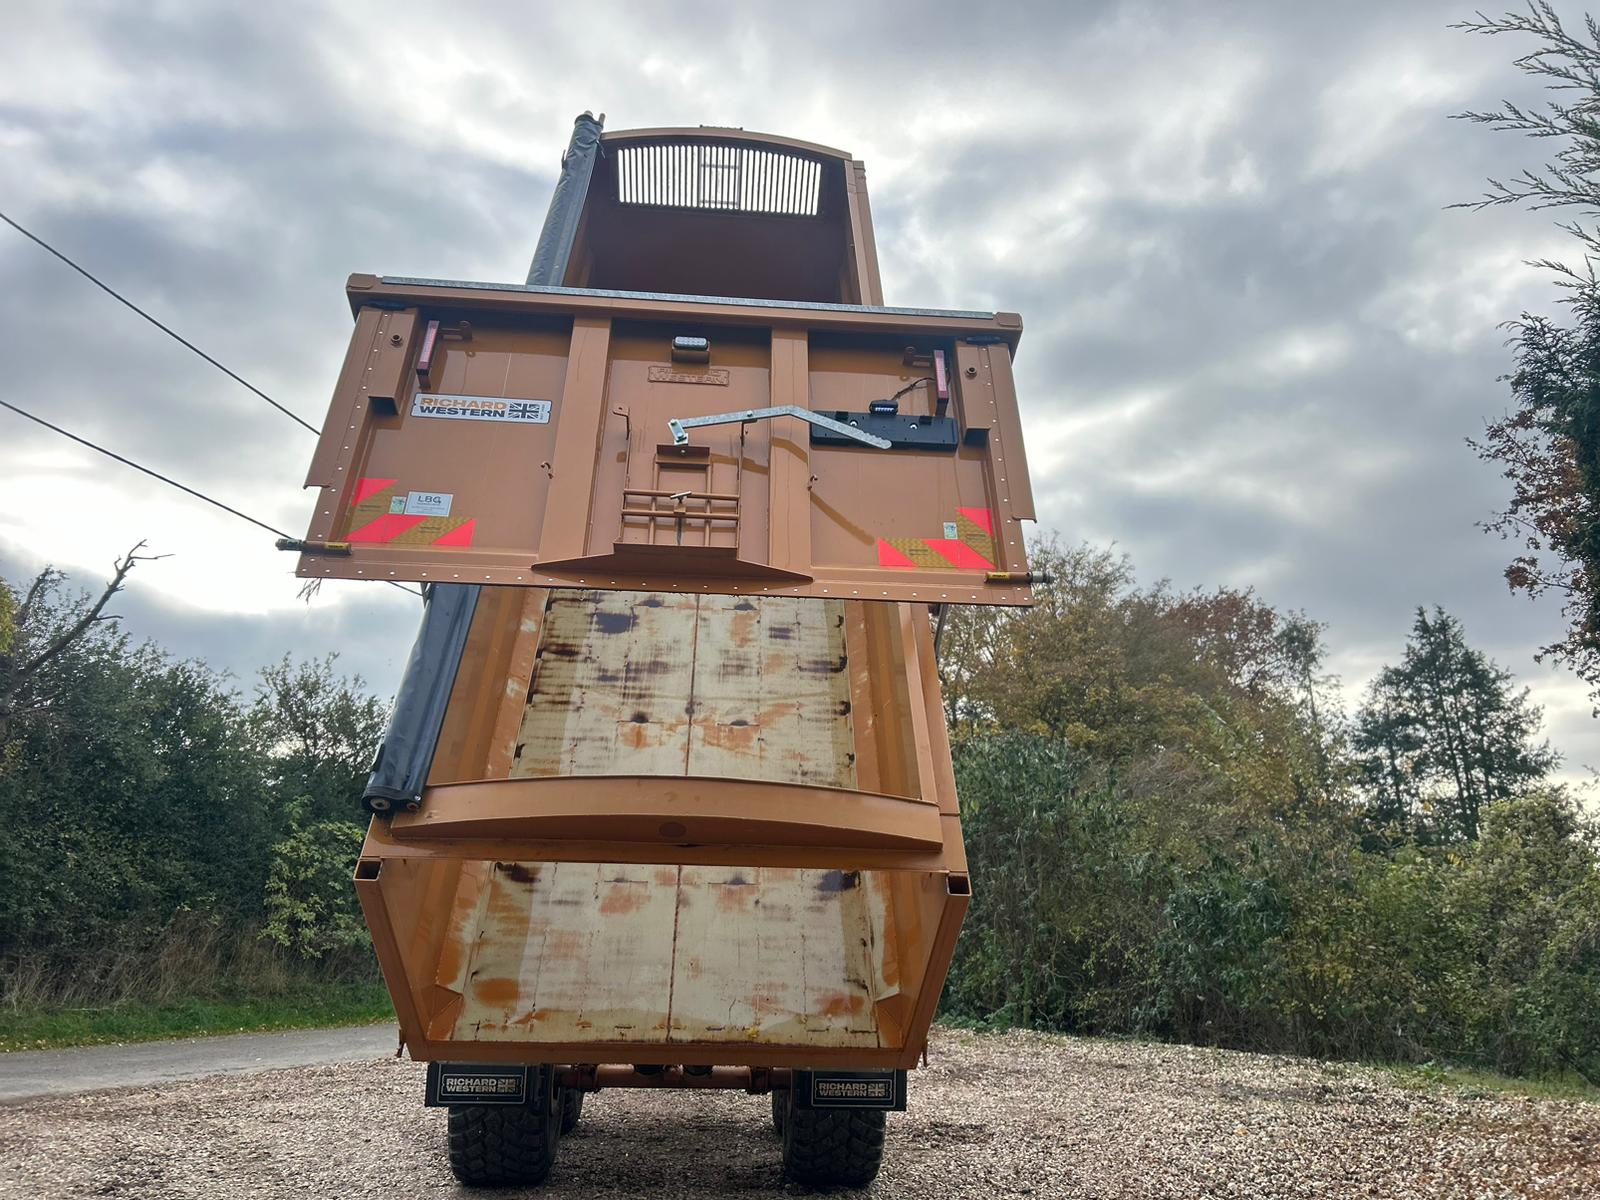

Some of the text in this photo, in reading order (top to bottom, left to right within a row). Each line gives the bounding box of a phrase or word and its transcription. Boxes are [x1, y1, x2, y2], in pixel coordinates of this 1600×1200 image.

[420, 397, 507, 410] RICHARD
[419, 406, 506, 418] WESTERN
[446, 1078, 497, 1086] RICHARD
[818, 1082, 867, 1090] RICHARD
[446, 1085, 496, 1093] WESTERN
[819, 1089, 867, 1097] WESTERN
